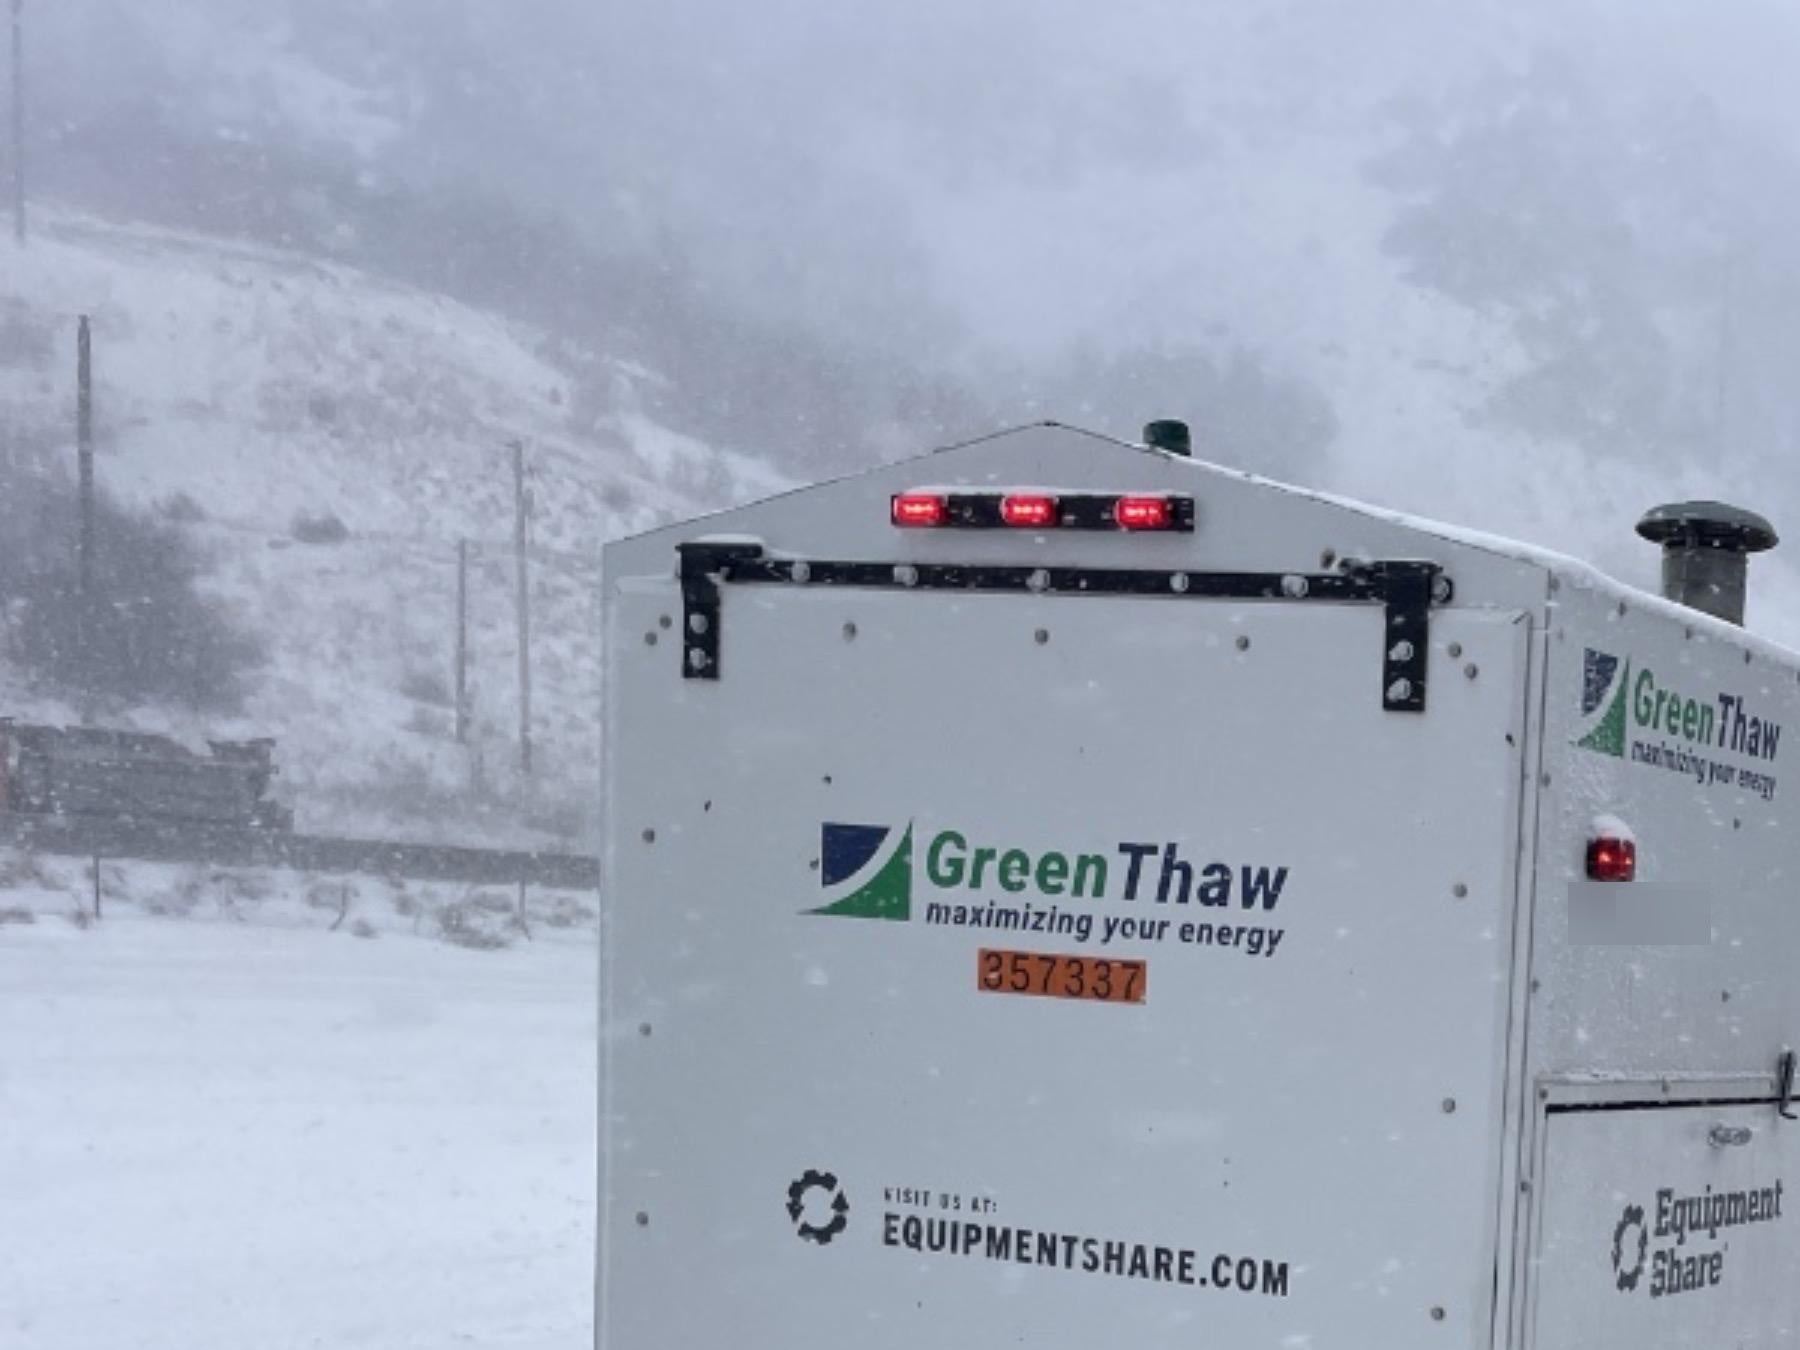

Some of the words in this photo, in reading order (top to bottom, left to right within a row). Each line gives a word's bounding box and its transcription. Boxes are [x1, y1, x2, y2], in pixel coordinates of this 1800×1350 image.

[1634, 668, 1781, 762] GreenThaw
[1631, 740, 1705, 784] maximizing
[1706, 761, 1736, 787] your
[1738, 768, 1777, 801] energy
[926, 829, 1290, 911] GreenThaw
[926, 900, 1093, 942] maximizing
[1101, 914, 1170, 945] your
[1179, 919, 1284, 957] energy
[982, 951, 1142, 1001] 357337
[884, 1187, 931, 1207] VISIT
[939, 1193, 961, 1210] US
[971, 1196, 998, 1214] AT:
[1653, 1178, 1783, 1246] Equipment
[883, 1212, 1290, 1297] EQUIPMENTSHARE.COM
[1650, 1248, 1723, 1298] Share
